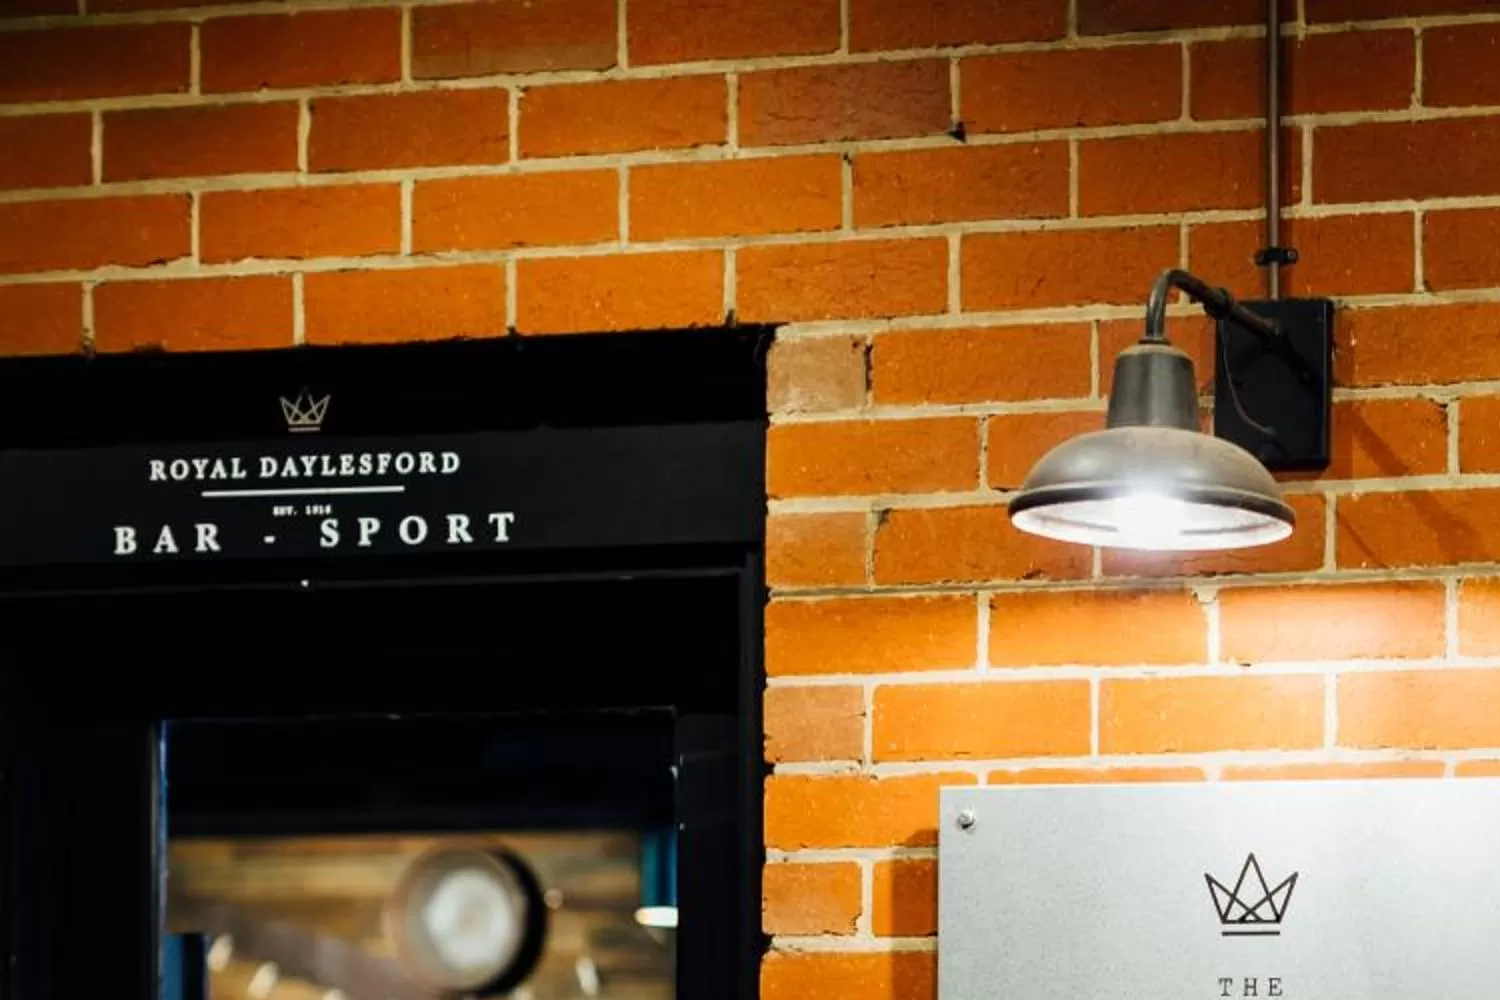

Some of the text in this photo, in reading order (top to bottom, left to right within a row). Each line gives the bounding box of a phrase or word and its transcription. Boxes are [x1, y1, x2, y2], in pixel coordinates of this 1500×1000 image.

[149, 451, 461, 481] ROYAL DAYLESFORD
[113, 522, 221, 555] BAR
[319, 512, 515, 548] SPORT
[1218, 977, 1285, 998] THE
